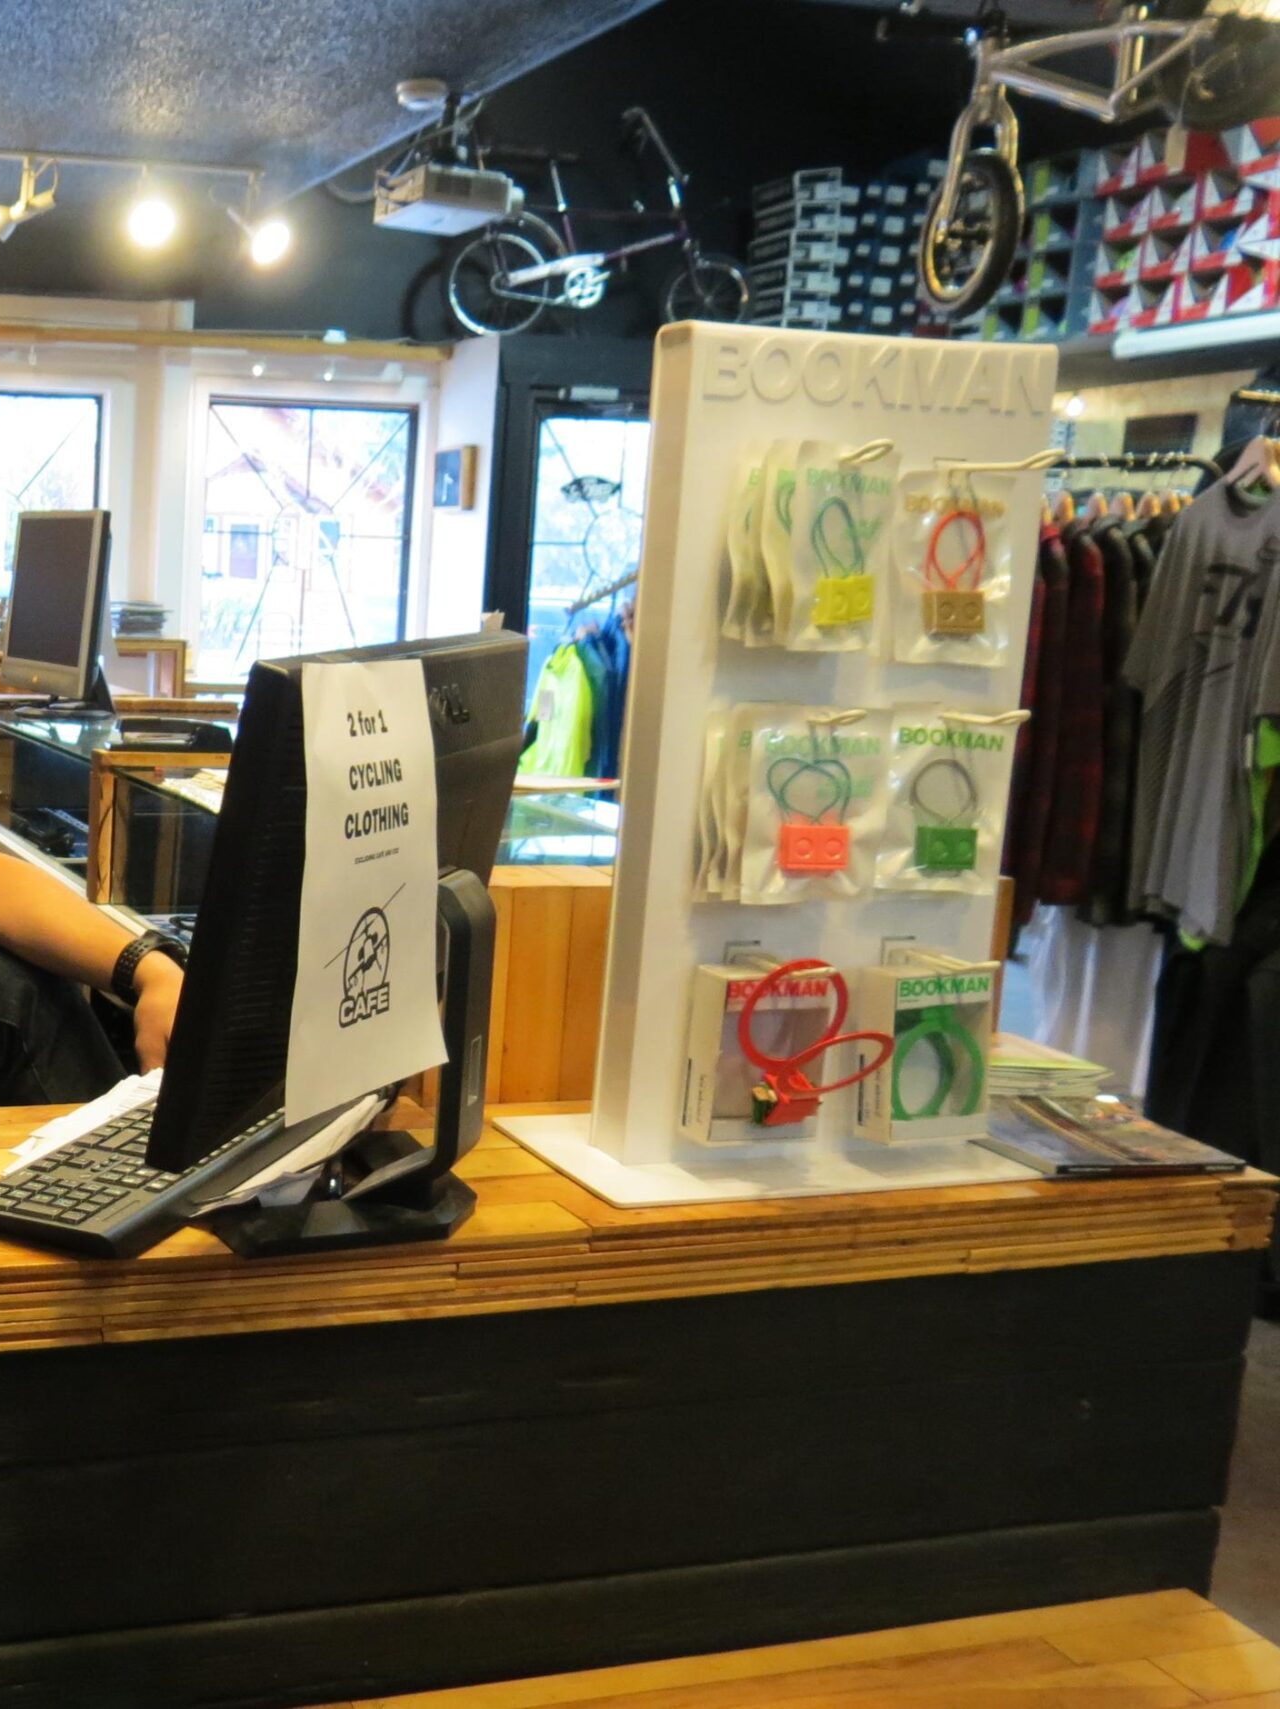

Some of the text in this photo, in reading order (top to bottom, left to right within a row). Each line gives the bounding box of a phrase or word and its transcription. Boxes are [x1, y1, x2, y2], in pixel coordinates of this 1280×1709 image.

[702, 341, 1046, 417] BOOKMAN
[347, 708, 389, 738] 2 for 1
[899, 726, 1005, 752] BOOKMAN
[349, 758, 403, 791] CYCLING
[344, 802, 409, 840] CLOTHING
[898, 976, 990, 998] BOOKMAN
[339, 981, 390, 1028] CAFE
